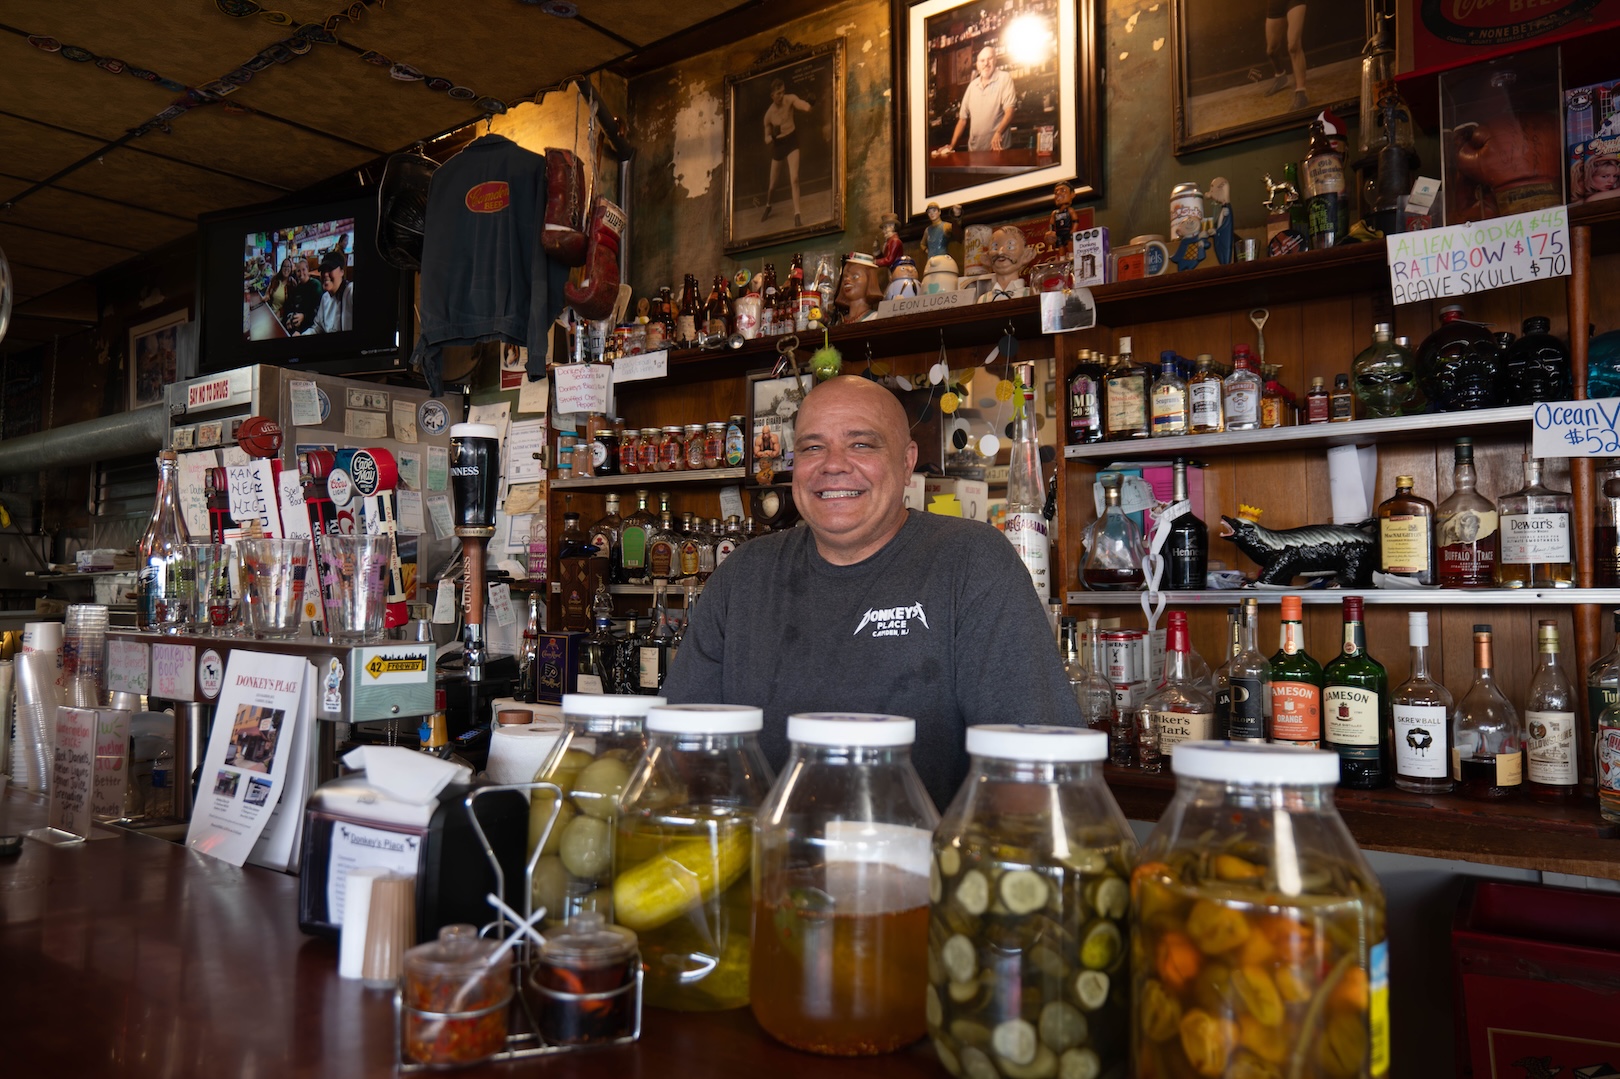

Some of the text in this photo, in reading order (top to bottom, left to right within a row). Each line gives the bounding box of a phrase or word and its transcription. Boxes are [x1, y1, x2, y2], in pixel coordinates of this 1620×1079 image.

[1478, 28, 1510, 39] NONE
[1395, 210, 1566, 260] ALIEN VODKA $45
[1393, 230, 1564, 282] RAINBOW $175
[1393, 254, 1566, 304] AGAVE SKULL $70
[892, 300, 920, 312] LEON
[922, 294, 958, 308] LUCAS
[190, 380, 229, 405] SAY NO TO DRUGS
[1073, 393, 1095, 407] MD
[1072, 406, 1095, 417] 20 20
[1535, 403, 1599, 430] Ocean
[1564, 428, 1620, 453] $52
[353, 456, 374, 472] Cape
[354, 469, 376, 484] May
[331, 480, 348, 490] Coors
[253, 469, 269, 527] ULTRA
[1444, 550, 1493, 562] BUFFALO TRACE
[877, 620, 907, 630] PLACE
[158, 662, 180, 677] BOOK
[370, 661, 420, 672] 42 Freeway
[236, 675, 298, 693] DONKEY'S PLACE
[1219, 694, 1231, 704] JA
[1325, 691, 1369, 703] JAMESON
[1277, 715, 1303, 724] ORANGE
[1397, 715, 1441, 725] SKREWBALL
[350, 832, 405, 851] Donkey's Place
